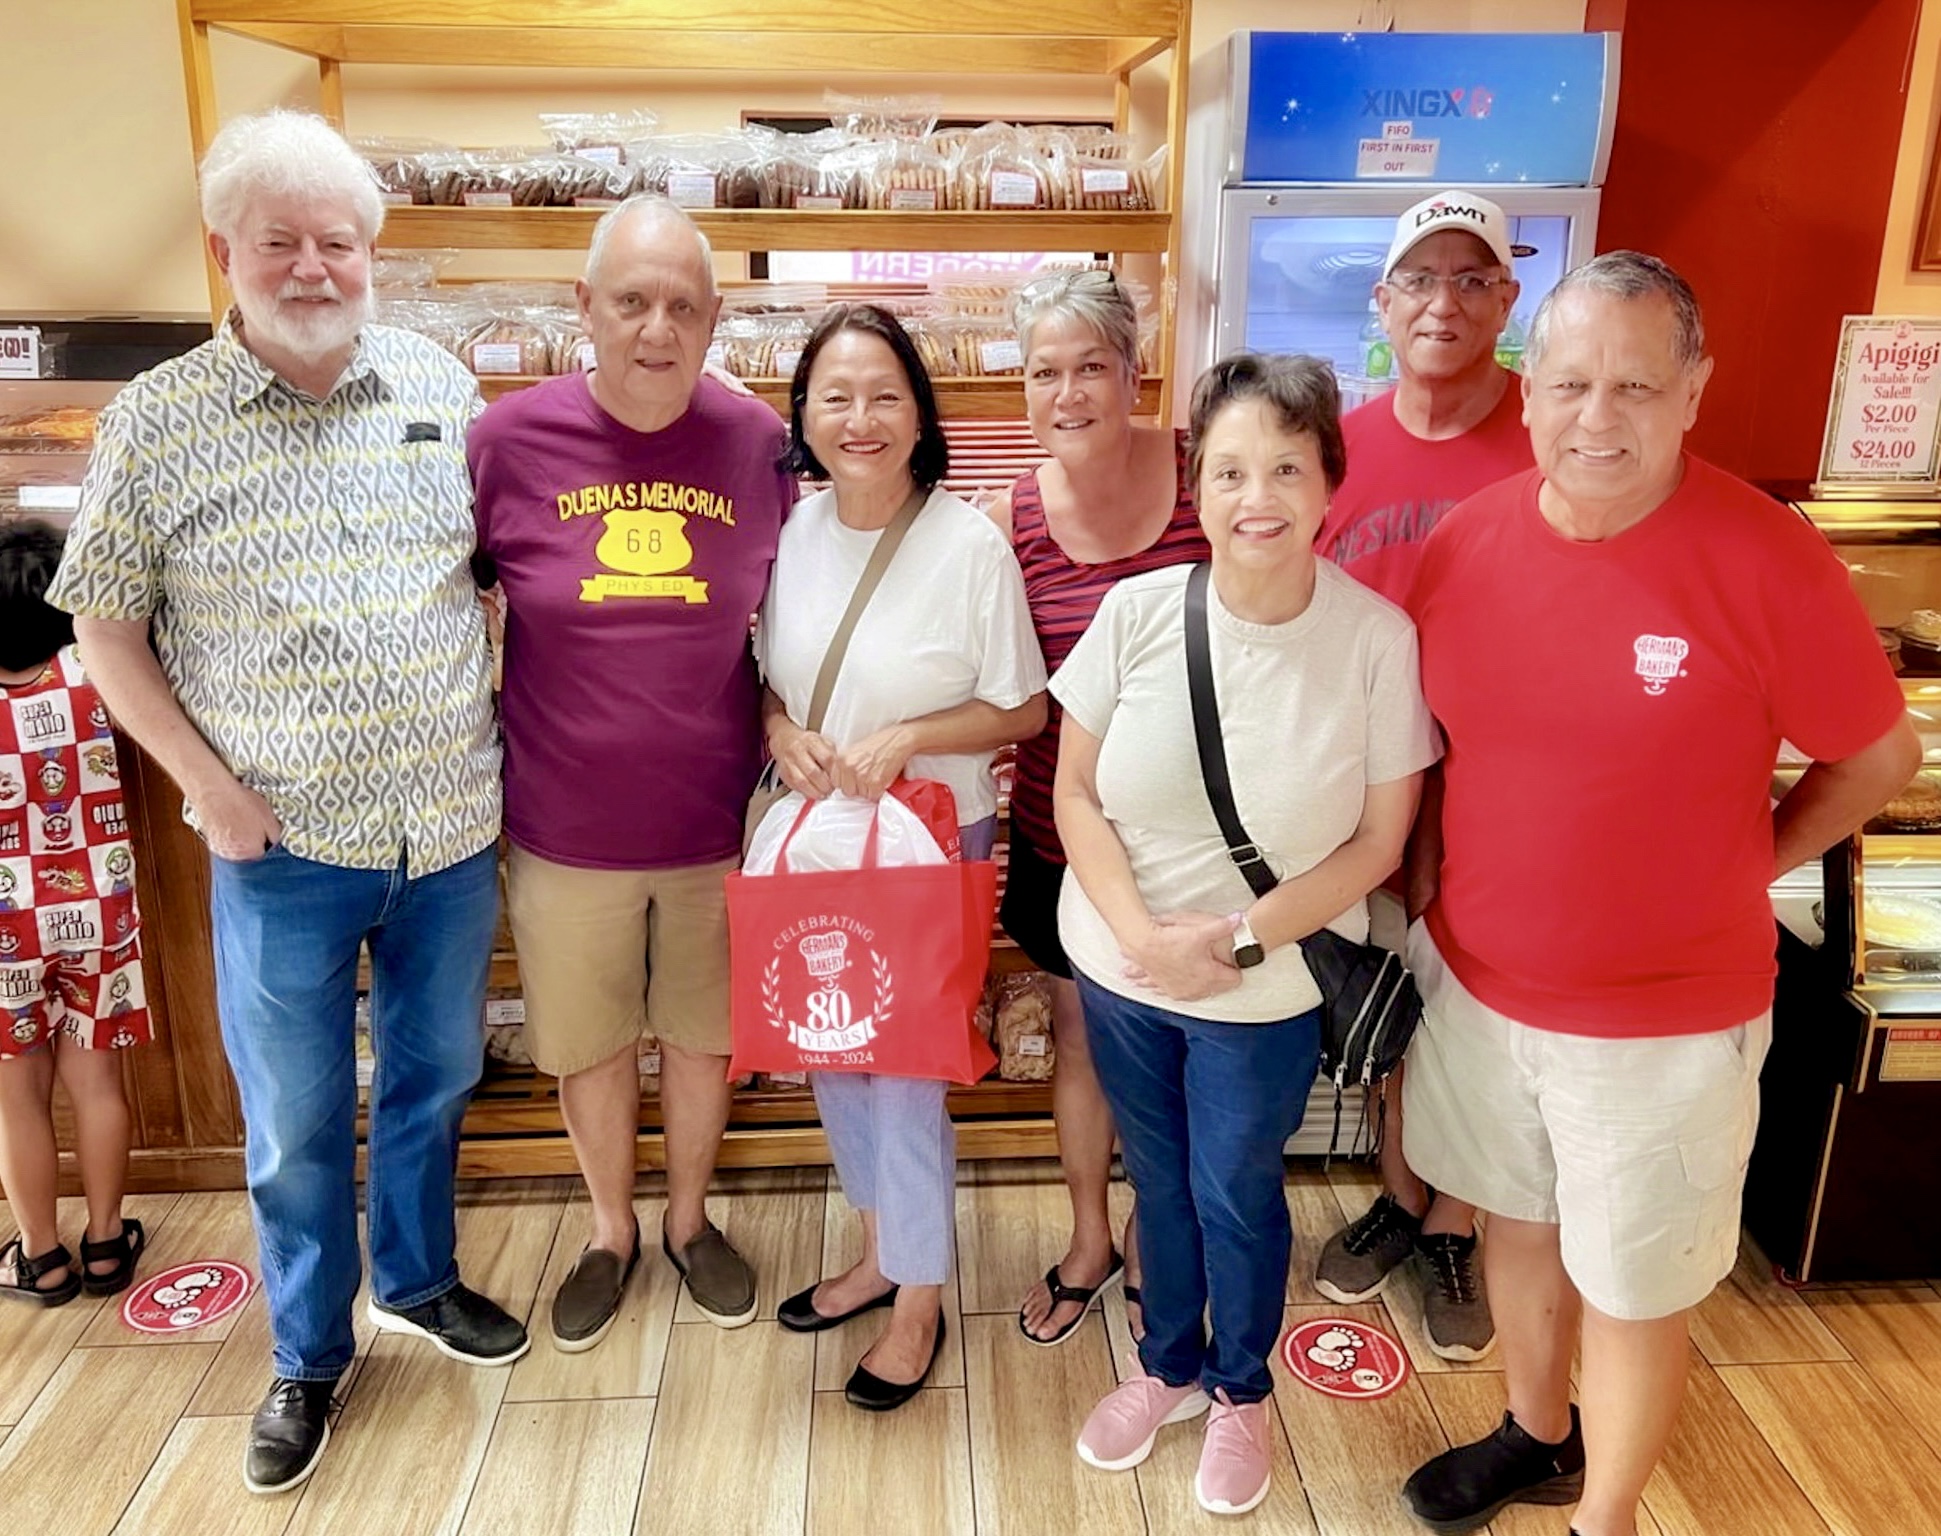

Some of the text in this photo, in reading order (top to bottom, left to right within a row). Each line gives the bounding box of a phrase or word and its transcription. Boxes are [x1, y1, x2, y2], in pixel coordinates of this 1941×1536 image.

[1387, 125, 1410, 136] FIFO
[1360, 142, 1434, 154] FIRST IN FIRST
[1384, 161, 1405, 172] OUT
[1859, 373, 1931, 385] Available for
[1861, 403, 1918, 425] $2.00
[1864, 424, 1910, 434] Per Piece
[1850, 439, 1917, 461] $24.00
[1871, 459, 1902, 469] Pieces
[556, 481, 737, 527] DUENAS MEMORIAL
[605, 579, 684, 593] PHYS ED
[1638, 658, 1678, 676] BAKERY
[773, 914, 875, 951] CELEBRATING
[809, 956, 842, 974] BAKERY
[806, 989, 852, 1033] 80
[803, 1029, 863, 1049] YEARS
[798, 1052, 829, 1065] 1944
[841, 1050, 875, 1065] 2024
